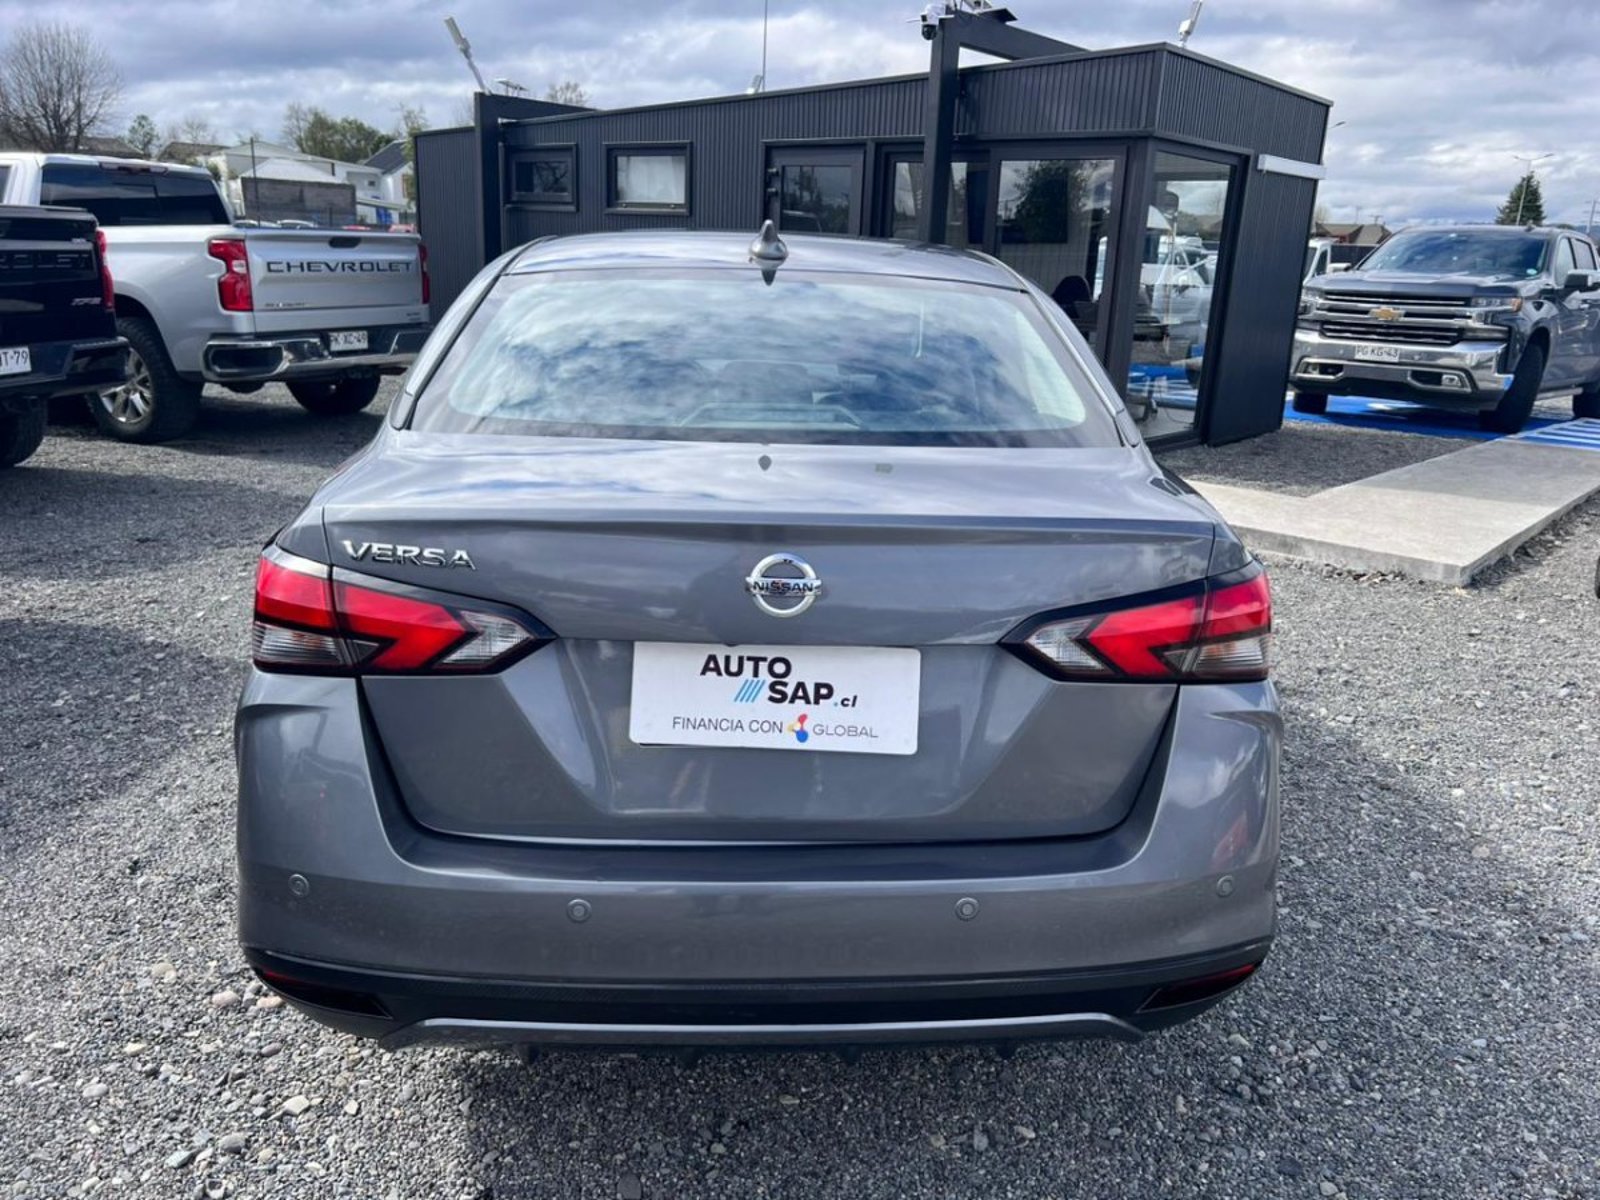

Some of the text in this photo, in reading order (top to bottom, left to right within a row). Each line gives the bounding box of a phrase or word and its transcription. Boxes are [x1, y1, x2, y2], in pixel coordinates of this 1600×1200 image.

[266, 261, 412, 273] CHEVROLET
[341, 540, 477, 571] VERSA
[753, 581, 813, 592] NISSAN
[700, 654, 792, 679] AUTO
[672, 716, 879, 738] FINANCIA CON GLOBAL
